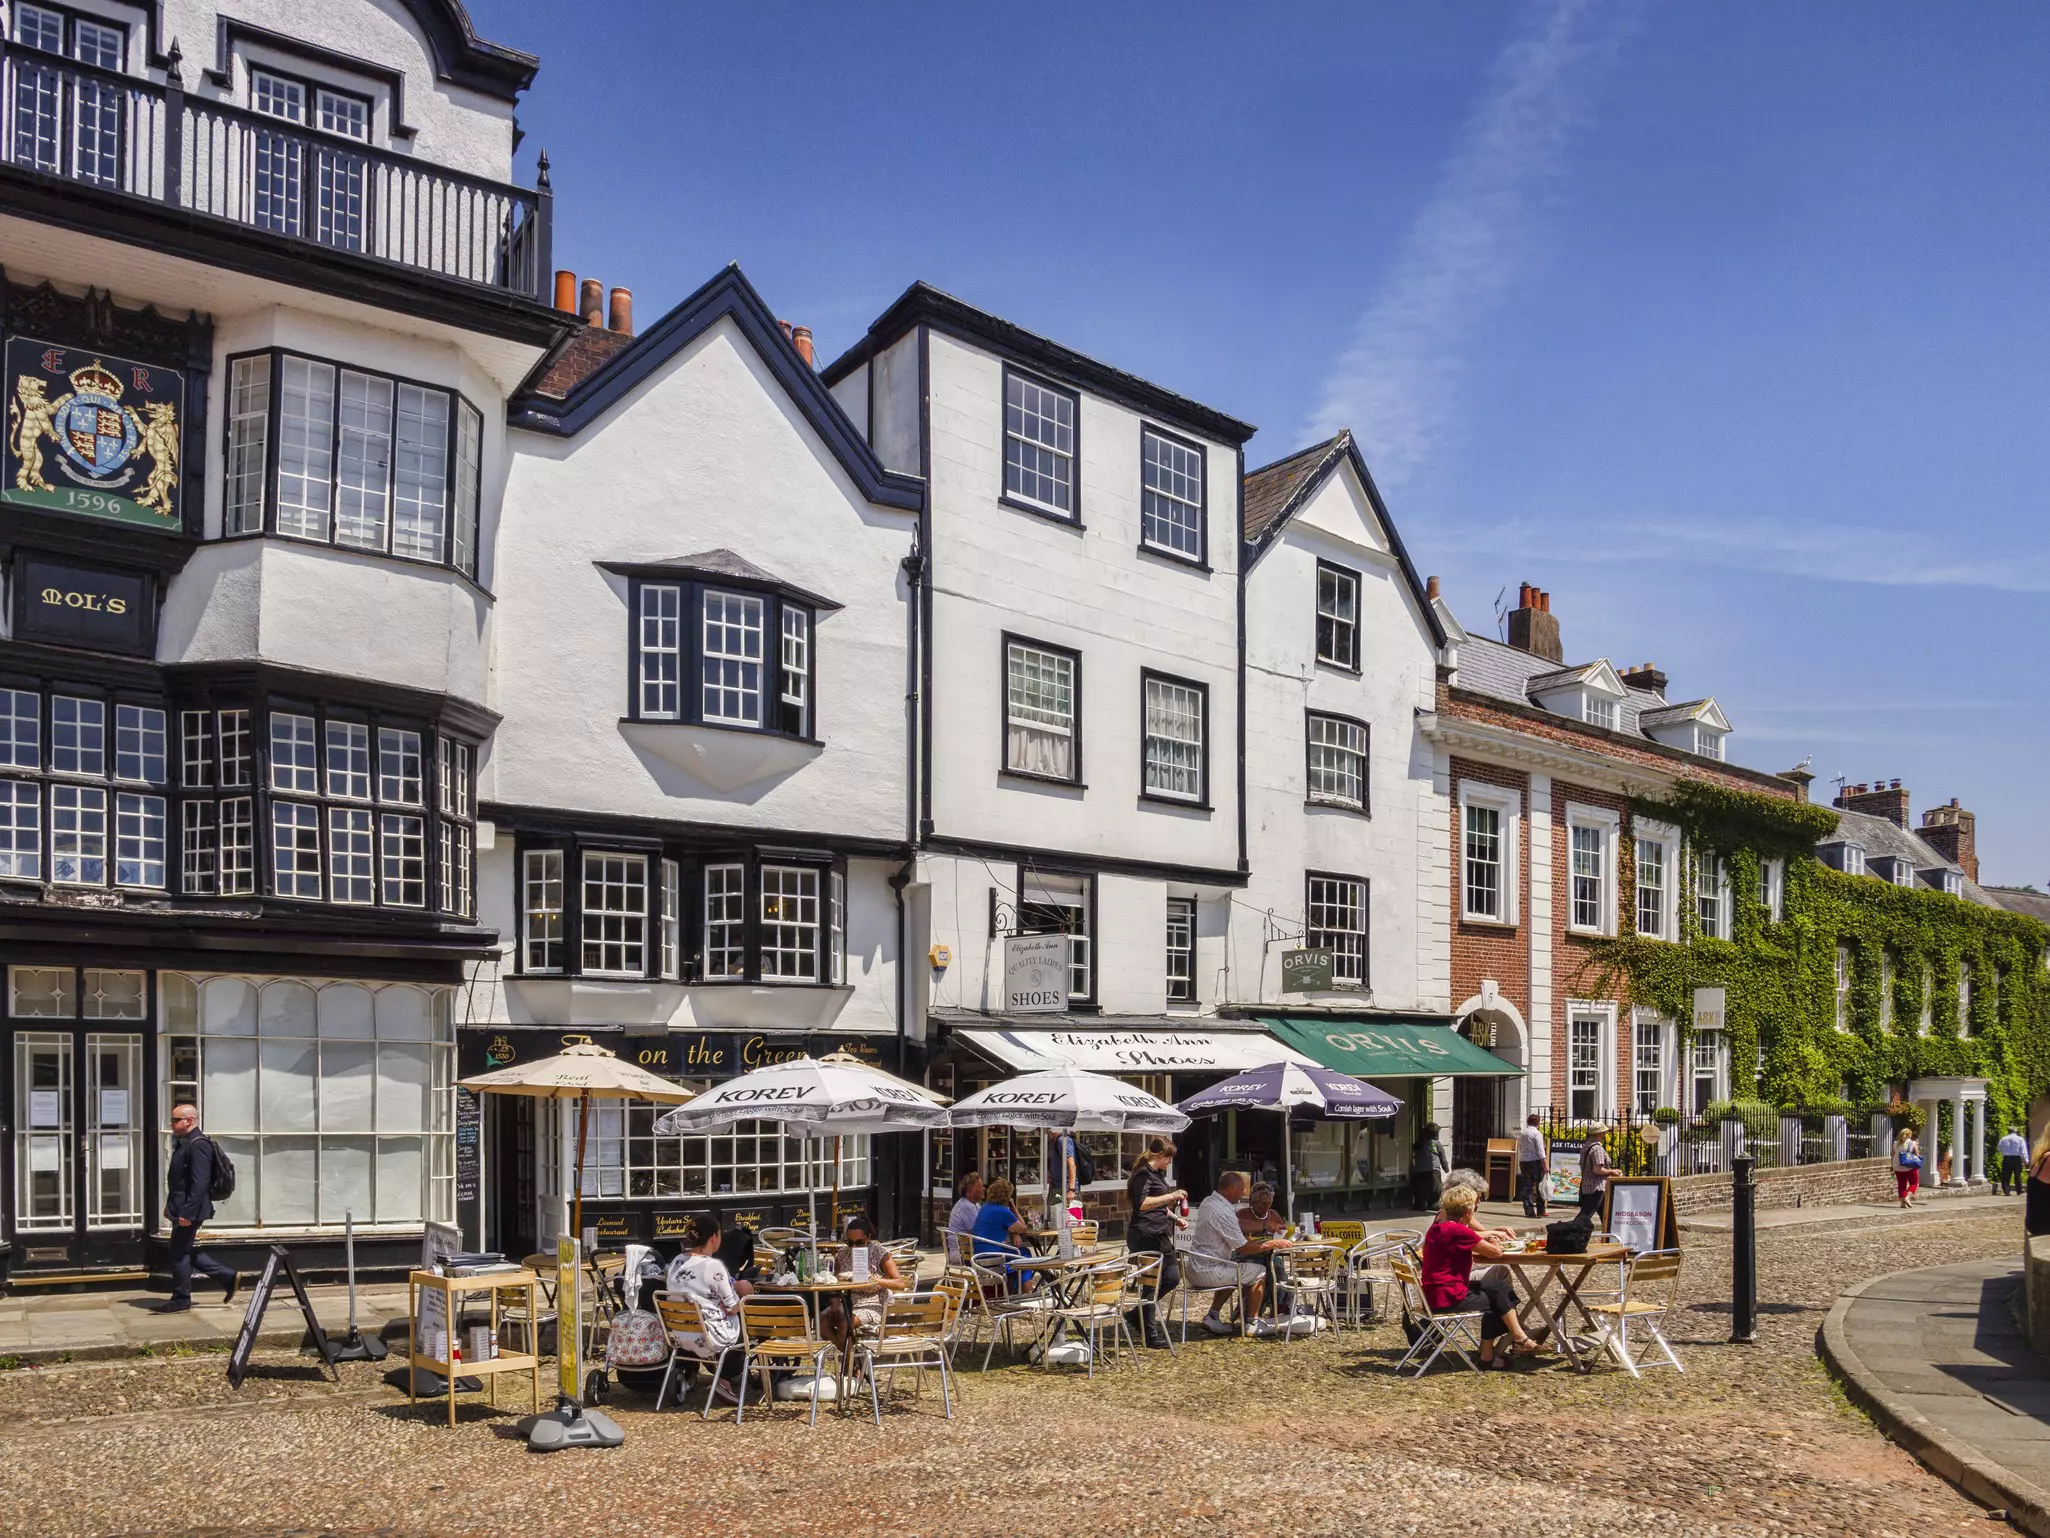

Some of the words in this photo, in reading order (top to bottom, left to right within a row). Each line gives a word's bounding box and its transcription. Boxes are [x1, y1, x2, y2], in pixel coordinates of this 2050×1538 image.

[41, 349, 66, 374] E
[131, 366, 153, 392] R
[66, 491, 121, 514] 1596
[41, 588, 126, 614] MOL'S
[1009, 956, 1037, 975] QUALITY
[1038, 957, 1063, 971] LADIES
[1284, 954, 1328, 968] ORVIS
[1012, 990, 1059, 1006] SHOES
[1697, 1011, 1714, 1025] ASK
[1471, 1022, 1490, 1046] ASK
[1052, 1033, 1157, 1050] Elizabeth
[1162, 1034, 1213, 1045] Ann
[1326, 1032, 1449, 1055] ORVIS
[639, 1050, 668, 1064] on
[688, 1036, 723, 1064] the
[860, 1043, 877, 1054] Rooms
[1116, 1050, 1216, 1065] Shoes
[554, 1072, 591, 1080] Real
[1219, 1083, 1267, 1092] KOREV
[1325, 1083, 1362, 1092] KOREV
[714, 1086, 816, 1103] KOREV
[982, 1093, 1067, 1104] KOREV
[1113, 1095, 1161, 1108] KOREV
[785, 1105, 804, 1113] Soul
[1334, 1104, 1352, 1112] Cornish
[1353, 1104, 1365, 1114] lager
[1378, 1104, 1391, 1112] Soul
[1041, 1112, 1056, 1120] Soul
[597, 1217, 624, 1226] Licensed
[656, 1216, 682, 1226] Upstairs
[735, 1212, 761, 1222] Breakfast
[1340, 1231, 1361, 1239] COFFEE
